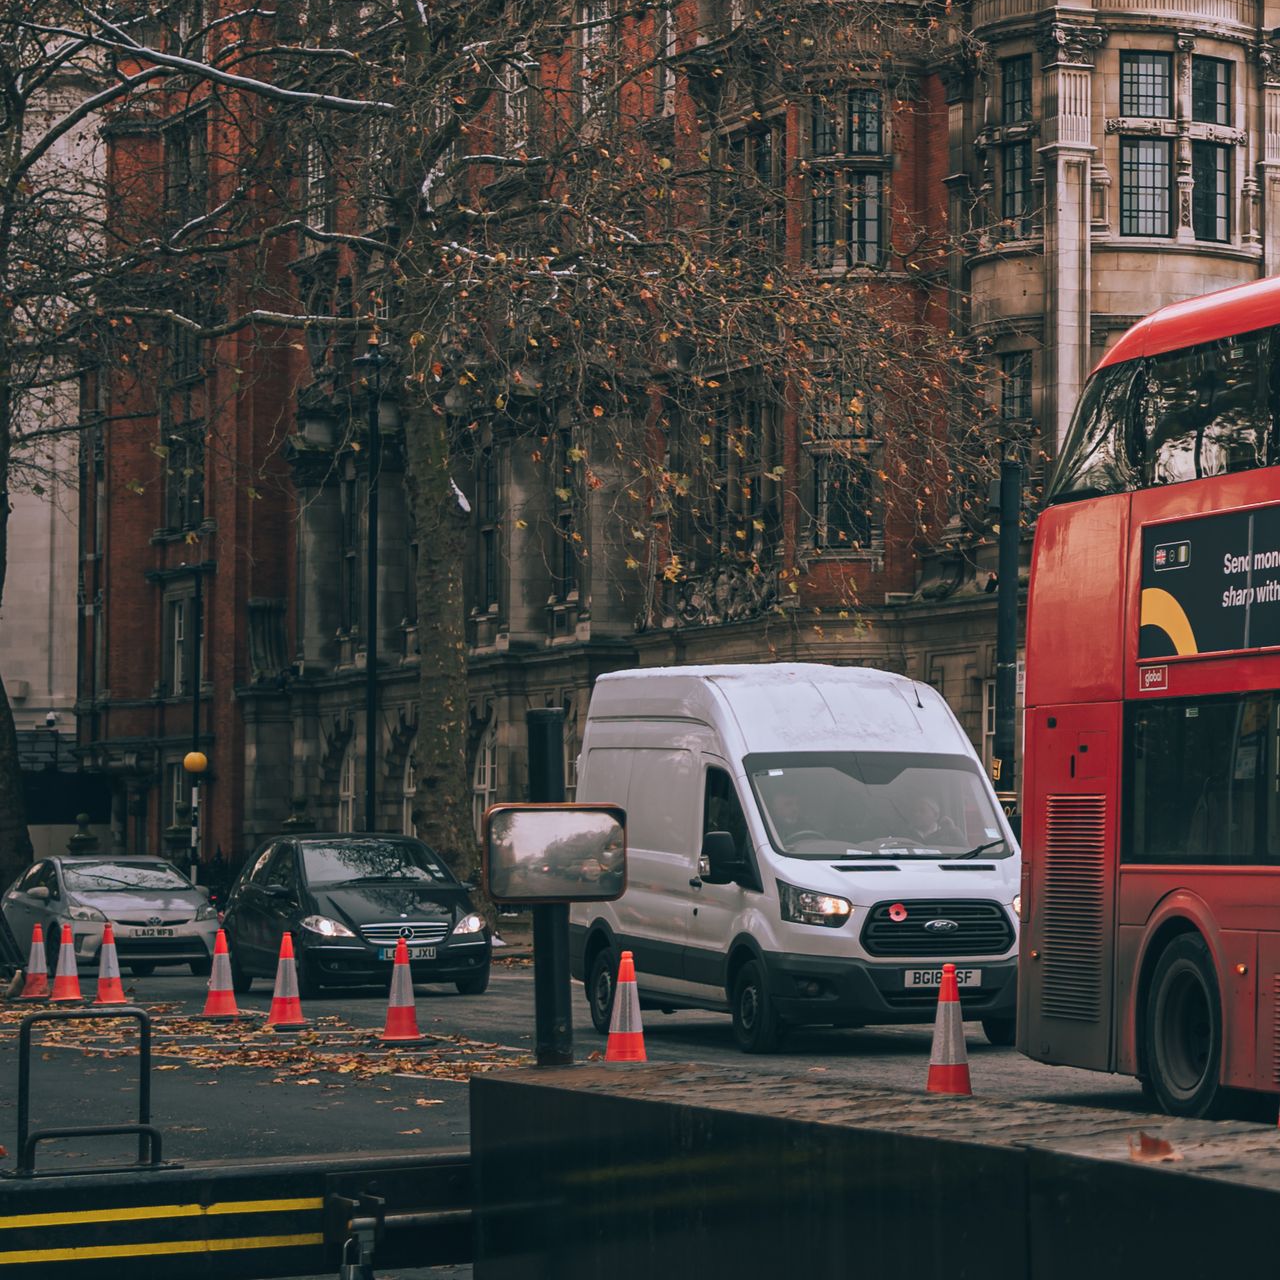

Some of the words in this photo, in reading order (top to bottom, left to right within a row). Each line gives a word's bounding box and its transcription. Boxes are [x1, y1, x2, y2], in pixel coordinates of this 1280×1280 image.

[1223, 549, 1252, 574] Send
[1222, 585, 1254, 610] sharp
[1256, 579, 1280, 603] with
[1144, 669, 1163, 688] global
[415, 947, 435, 958] JXU
[912, 971, 943, 985] BG18
[955, 970, 973, 984] SF
